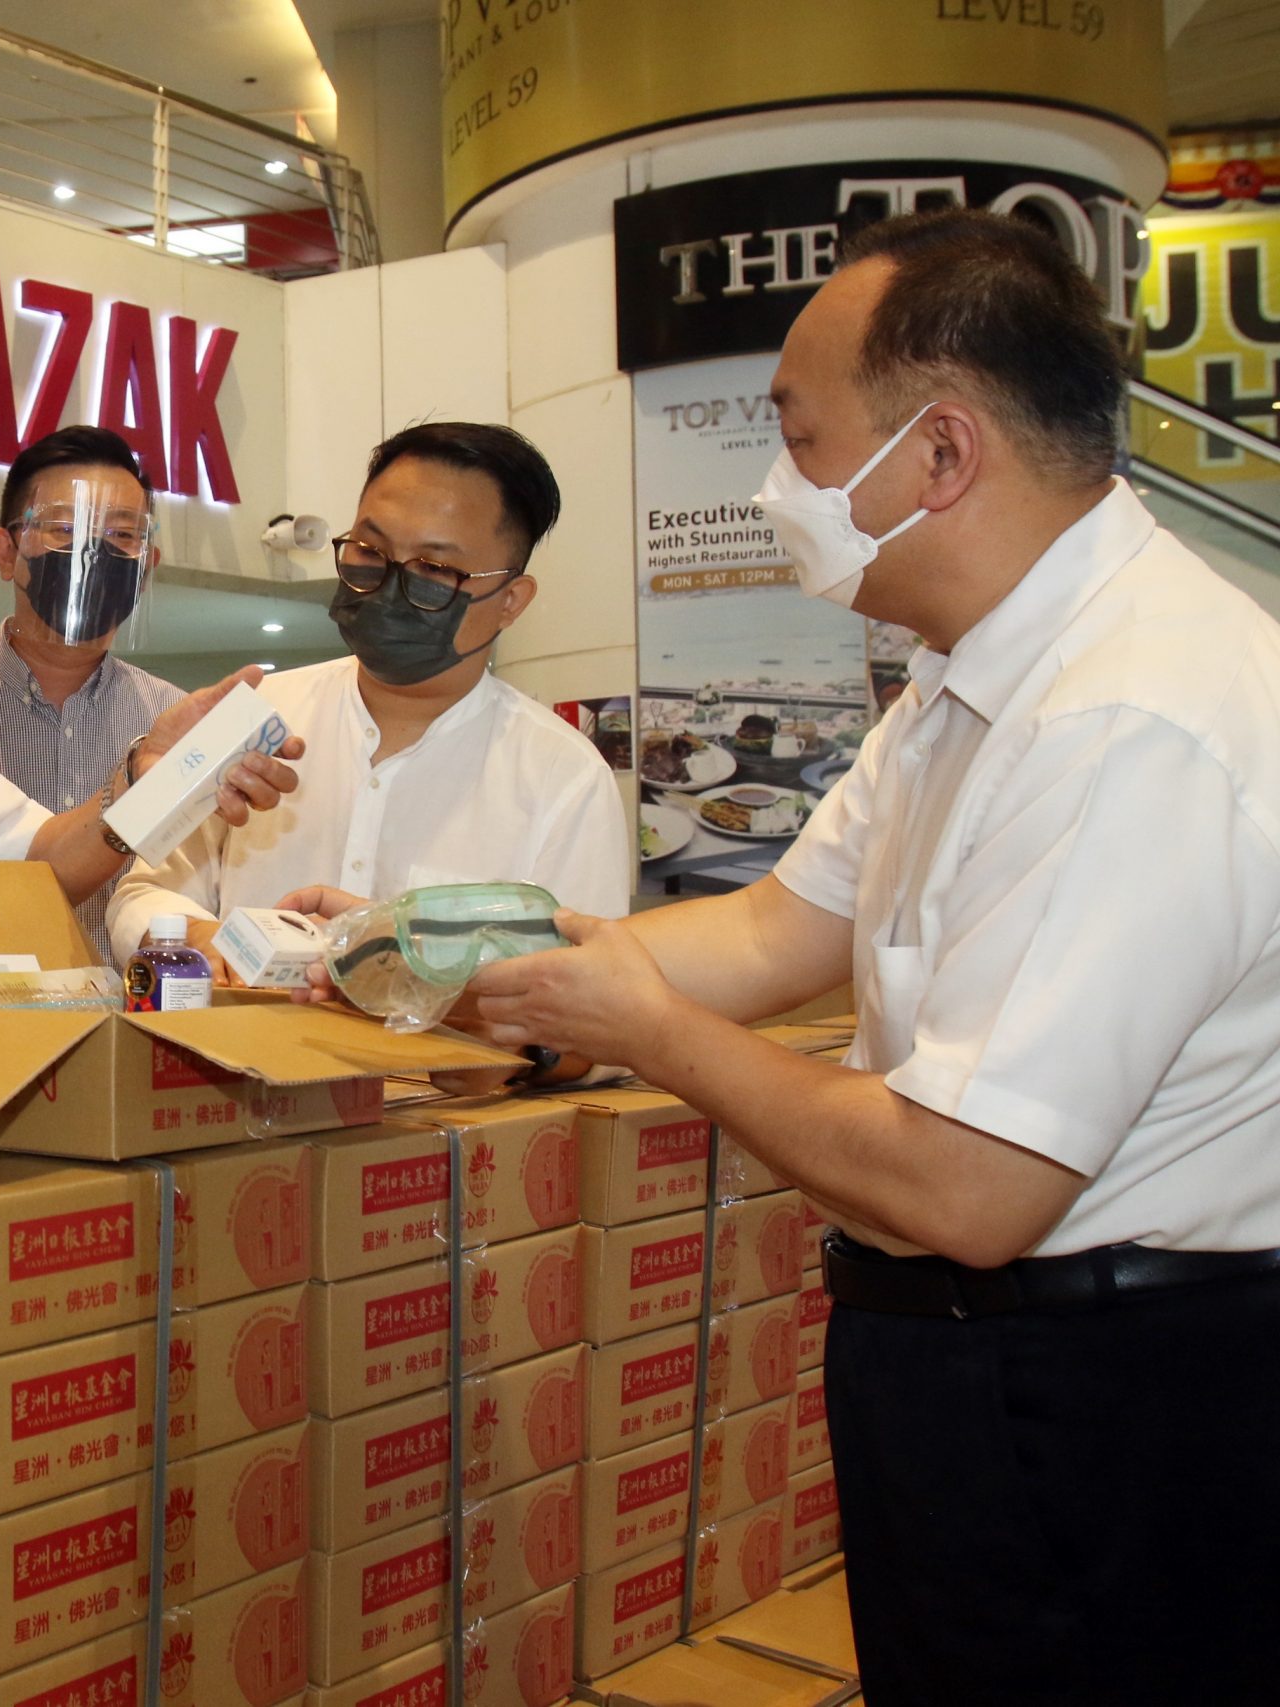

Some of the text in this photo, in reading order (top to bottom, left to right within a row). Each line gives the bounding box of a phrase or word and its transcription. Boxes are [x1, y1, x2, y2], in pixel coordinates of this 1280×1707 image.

[507, 66, 538, 110] 59
[659, 223, 840, 305] THE
[662, 398, 730, 432] TOP
[648, 502, 764, 531] Executive
[648, 527, 775, 551] with Stunning
[648, 554, 697, 569] Highest
[701, 547, 779, 563] Restaurant
[663, 576, 692, 589] MON
[704, 573, 728, 586] SAT
[739, 569, 775, 583] 12PM
